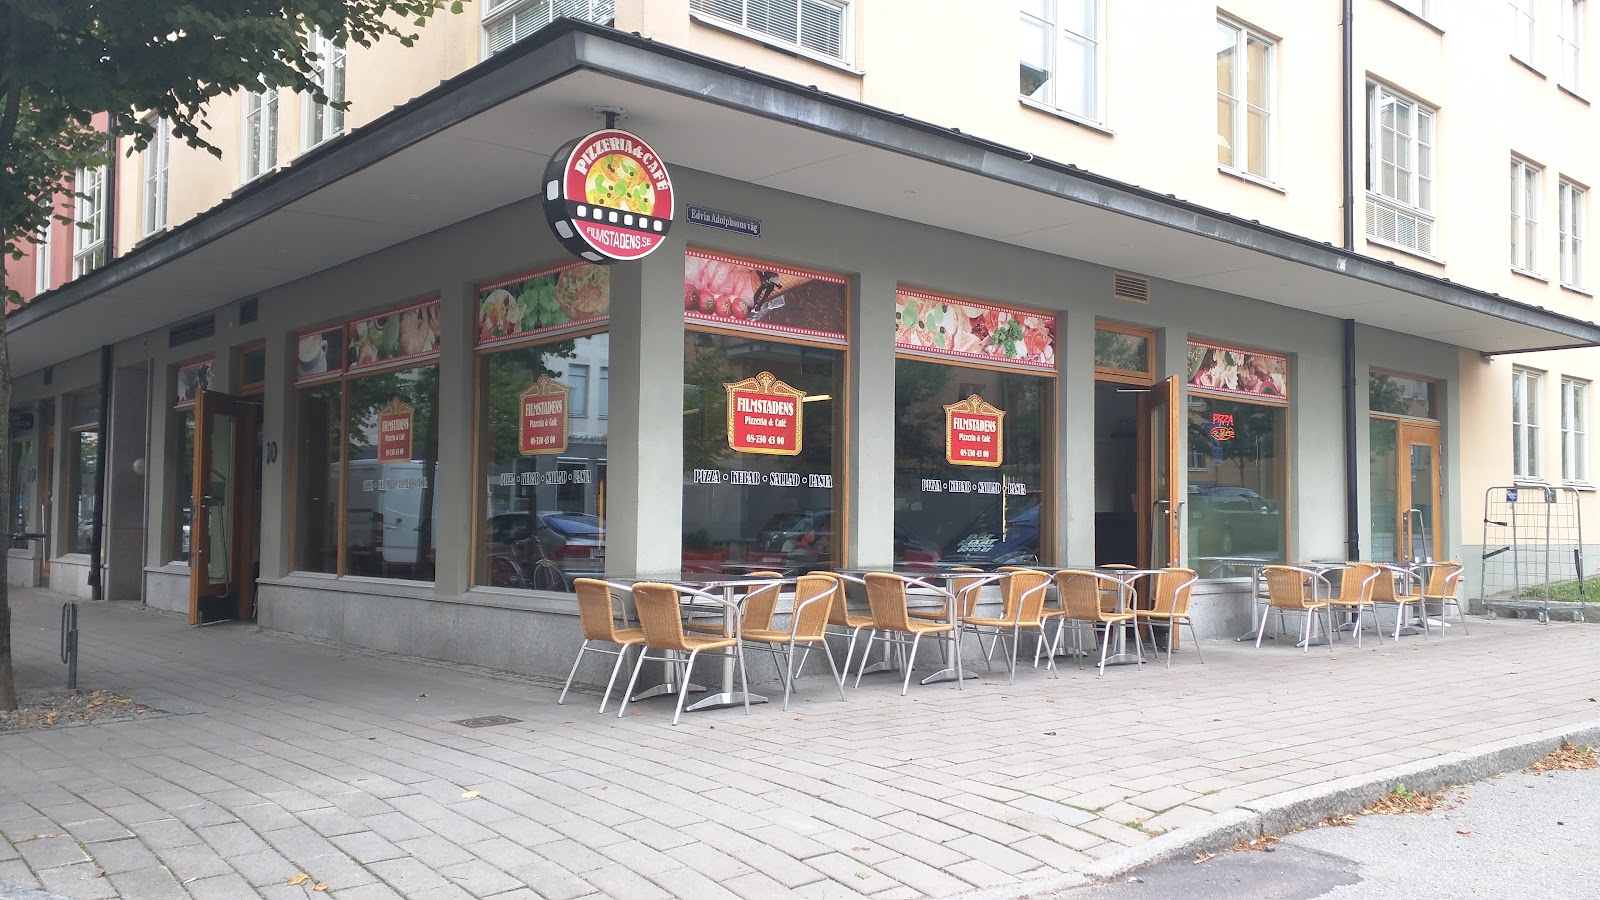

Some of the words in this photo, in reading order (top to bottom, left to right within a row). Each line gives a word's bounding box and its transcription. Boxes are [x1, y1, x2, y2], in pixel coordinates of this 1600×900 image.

[691, 209, 710, 221] Edvin
[711, 213, 746, 229] Adolphsons
[747, 222, 758, 233] väg
[586, 226, 652, 250] FILMSTADENS.SE
[525, 400, 562, 416] FILMSTADENS
[737, 397, 794, 416] FILMSTADENS
[530, 419, 544, 428] Pizzeria
[744, 415, 767, 426] Pizzeria
[768, 418, 773, 426] &
[775, 418, 787, 427] Café
[954, 417, 996, 432] FILMSTADENS
[1212, 413, 1234, 425] PIZZA
[550, 435, 556, 444] 00
[746, 433, 767, 444] 08-730
[768, 435, 775, 444] 43
[776, 436, 785, 445] 00
[958, 432, 976, 442] Pizzeria
[267, 441, 278, 464] 10
[983, 450, 989, 458] 00
[694, 469, 722, 484] PIZZA
[730, 470, 760, 486] KEBAB
[769, 472, 800, 487] SALLAD
[809, 474, 833, 489] PASTA
[922, 479, 942, 492] PIZZA
[949, 480, 971, 493] KEBAB
[978, 481, 1001, 494] SALLAD
[1008, 483, 1027, 496] PASTA
